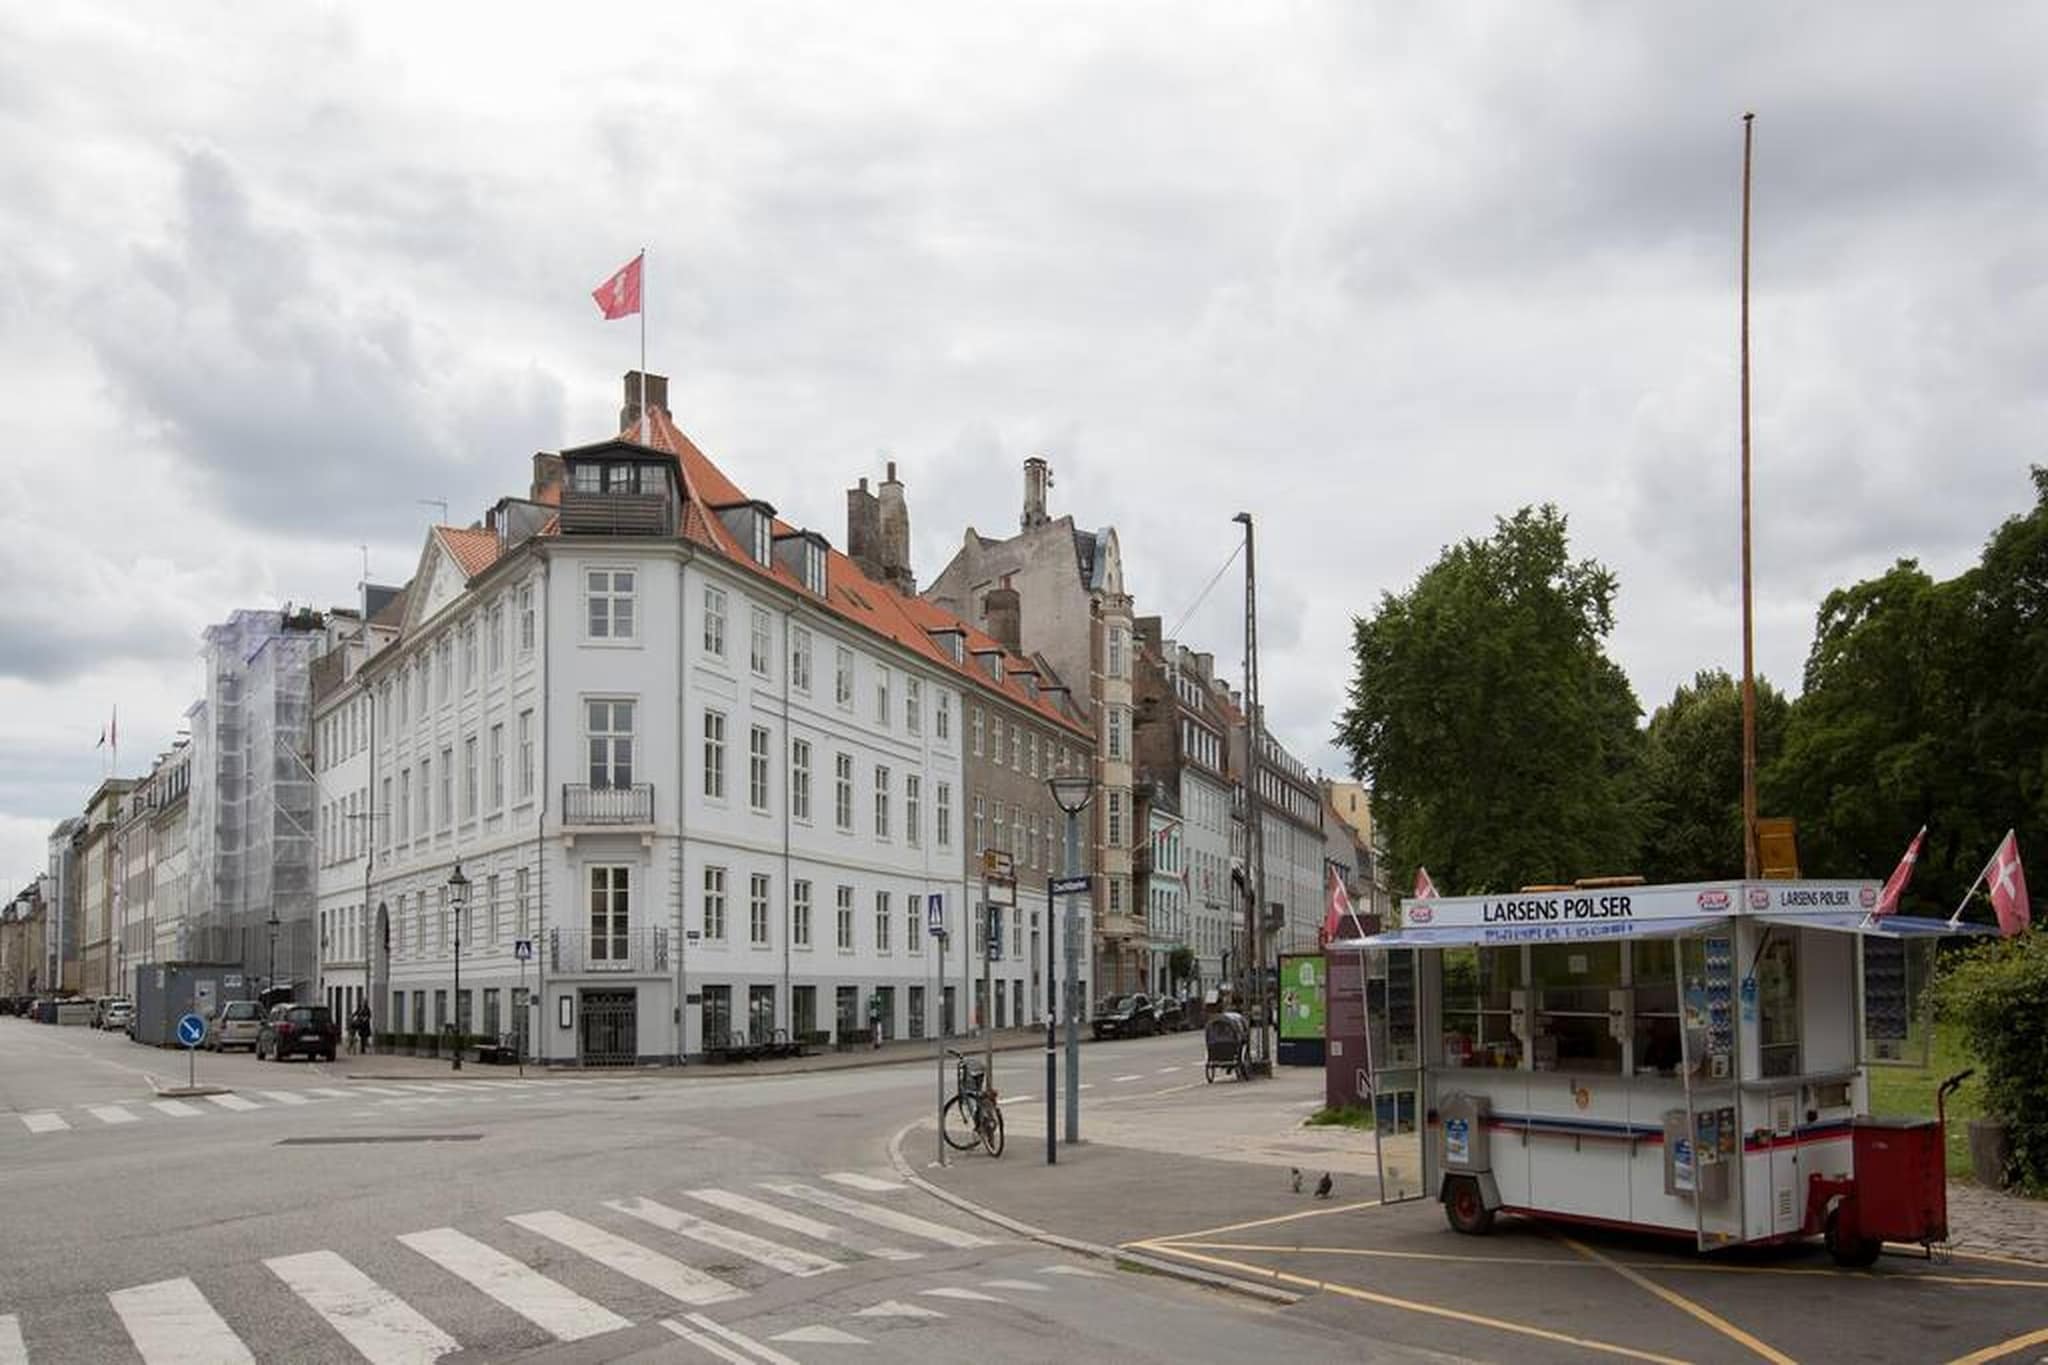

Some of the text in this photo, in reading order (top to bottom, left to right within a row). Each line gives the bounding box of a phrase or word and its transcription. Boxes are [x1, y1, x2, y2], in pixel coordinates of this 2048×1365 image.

[1483, 895, 1633, 923] LARSENS PØLSER
[1780, 890, 1818, 907] LARSENS
